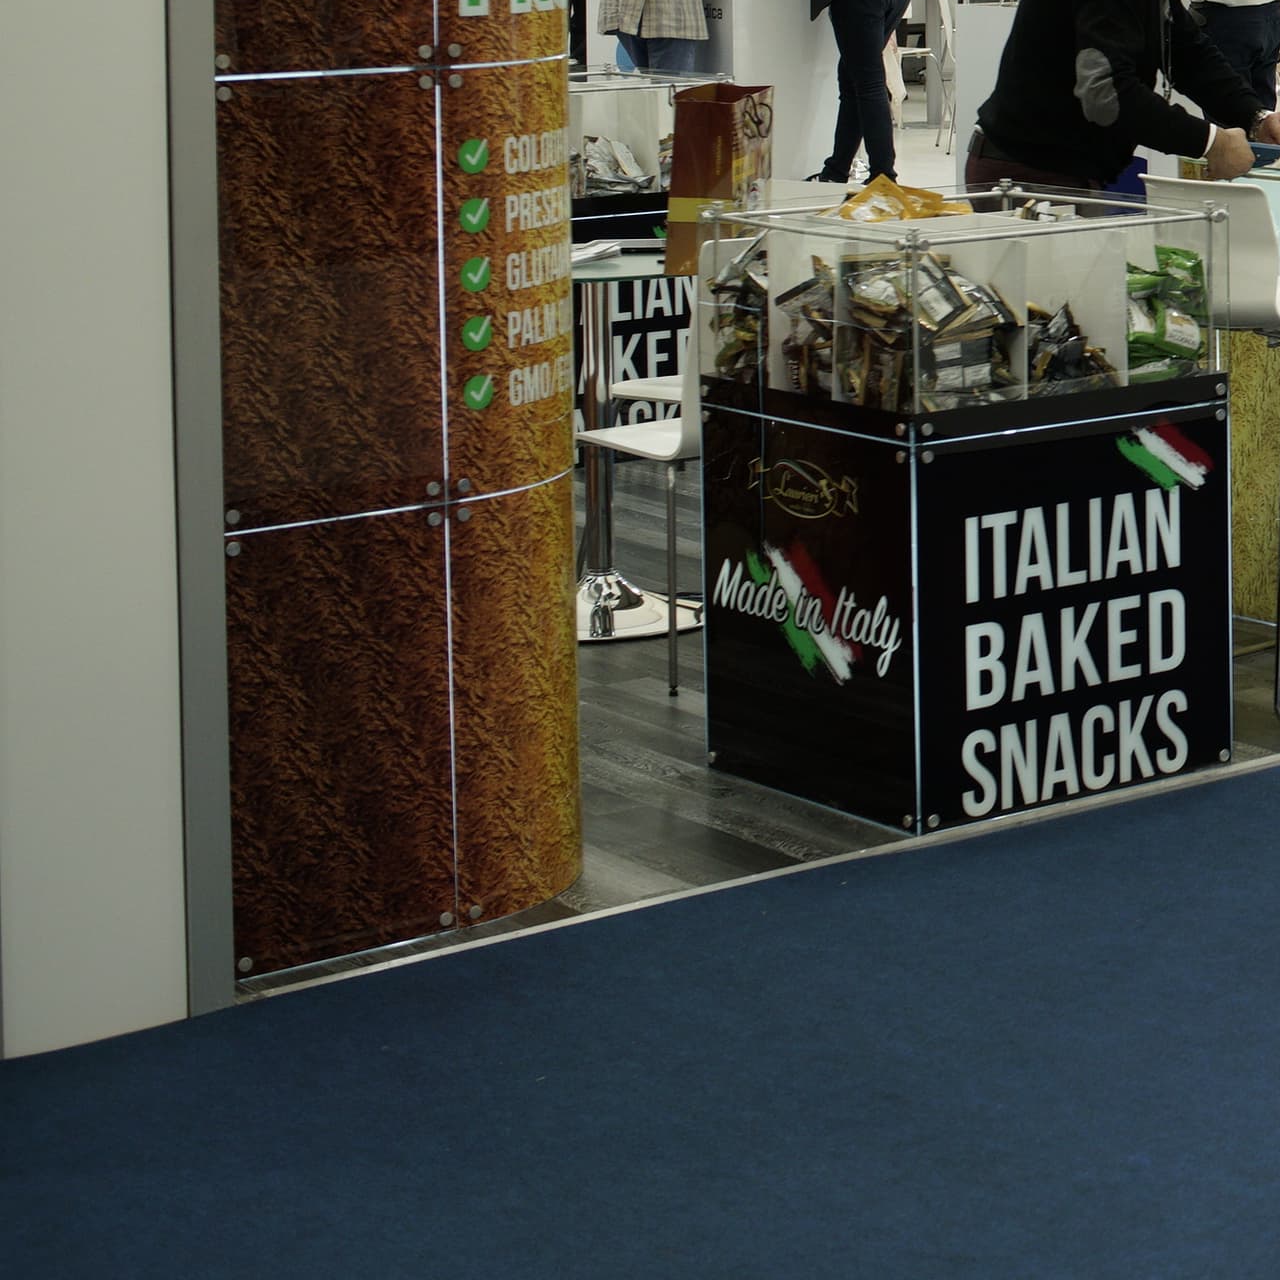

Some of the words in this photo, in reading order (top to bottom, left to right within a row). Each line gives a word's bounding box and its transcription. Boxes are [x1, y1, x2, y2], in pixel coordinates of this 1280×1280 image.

[965, 486, 1182, 604] ITALIAN
[713, 558, 789, 624] Made
[795, 584, 824, 634] in
[829, 586, 902, 678] Italy
[966, 588, 1187, 711] BAKED
[961, 689, 1189, 818] SNACKS
